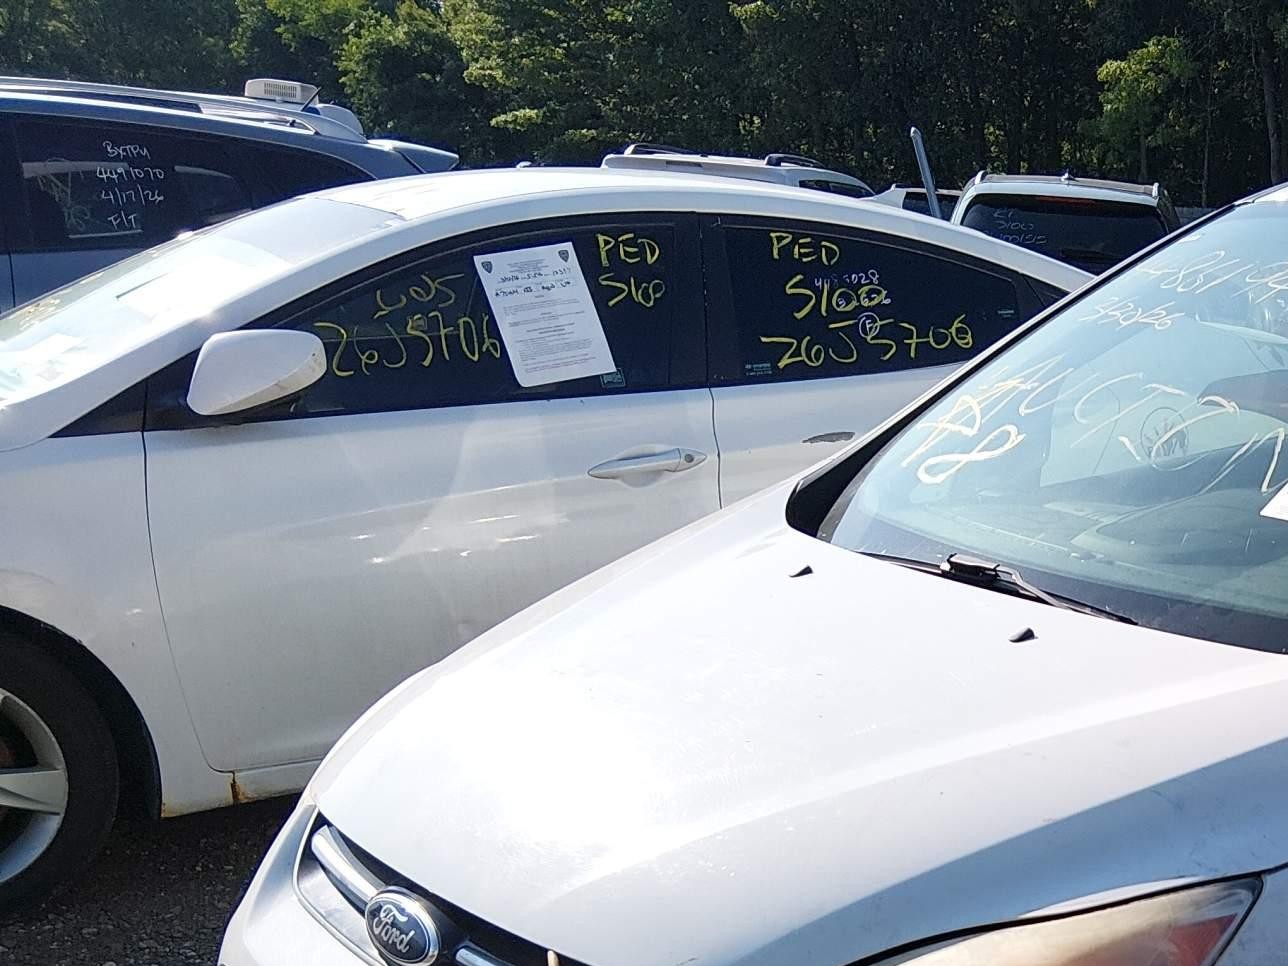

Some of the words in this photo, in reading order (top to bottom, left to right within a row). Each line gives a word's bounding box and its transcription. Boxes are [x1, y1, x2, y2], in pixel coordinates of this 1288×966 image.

[597, 233, 661, 268] PED
[769, 232, 840, 266] PED
[372, 903, 416, 954] Ford
